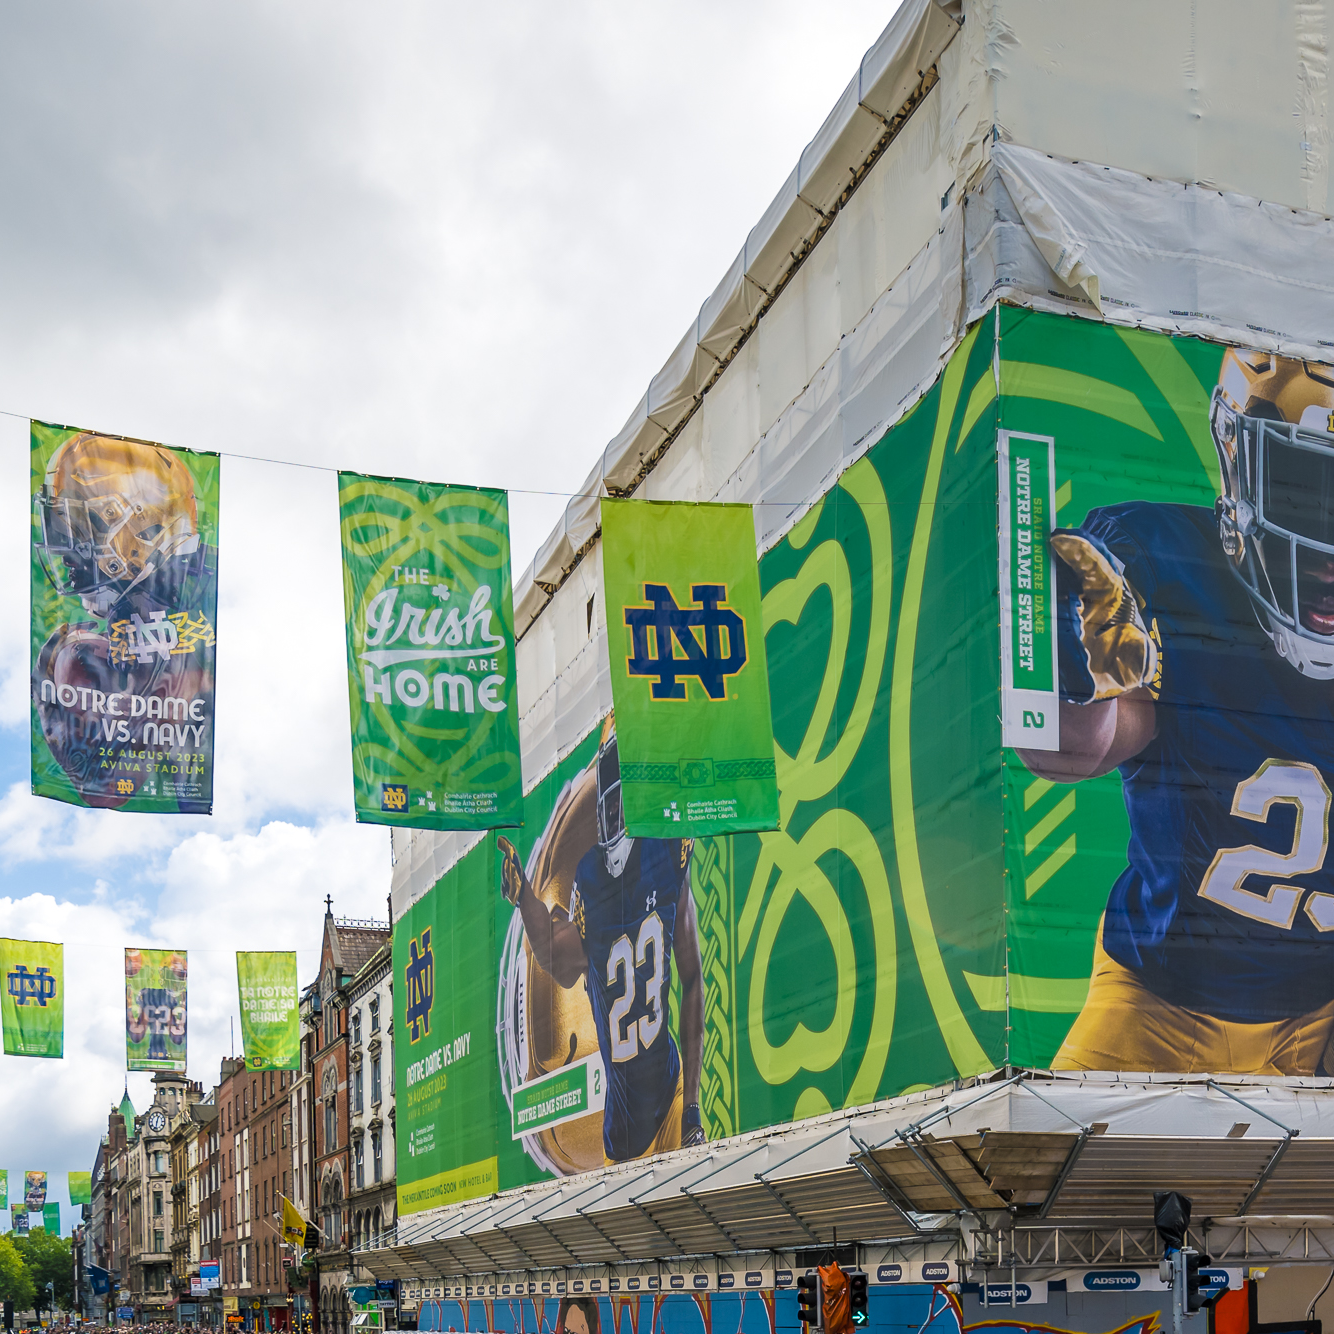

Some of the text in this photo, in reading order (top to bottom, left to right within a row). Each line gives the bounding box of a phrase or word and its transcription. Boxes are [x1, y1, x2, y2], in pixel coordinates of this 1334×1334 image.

[1017, 457, 1034, 671] NOTRE DAME STREET
[391, 565, 429, 585] THE
[364, 585, 505, 648] Irish
[467, 658, 498, 671] ARE
[364, 665, 507, 713] HOME
[41, 680, 206, 722] NOTRE DAME
[1022, 709, 1045, 728] 2
[102, 718, 205, 747] VS. NAVY
[99, 747, 205, 762] 26 AUGUST 2023
[101, 760, 204, 774] AVIVA STADIUM
[257, 985, 295, 997] NOTRE
[607, 911, 664, 1063] 23
[243, 999, 294, 1010] DAME SA
[407, 1059, 424, 1087] NOTRE
[426, 1048, 442, 1077] DAME
[454, 1032, 470, 1062] NAVY
[414, 1081, 434, 1102] AUGUST
[594, 1069, 601, 1095] 2
[517, 1088, 581, 1125] NOTRE DAME STREET
[880, 1269, 900, 1277] ADSTON
[926, 1267, 947, 1276] ADSTON
[1092, 1277, 1137, 1285] ADSTON
